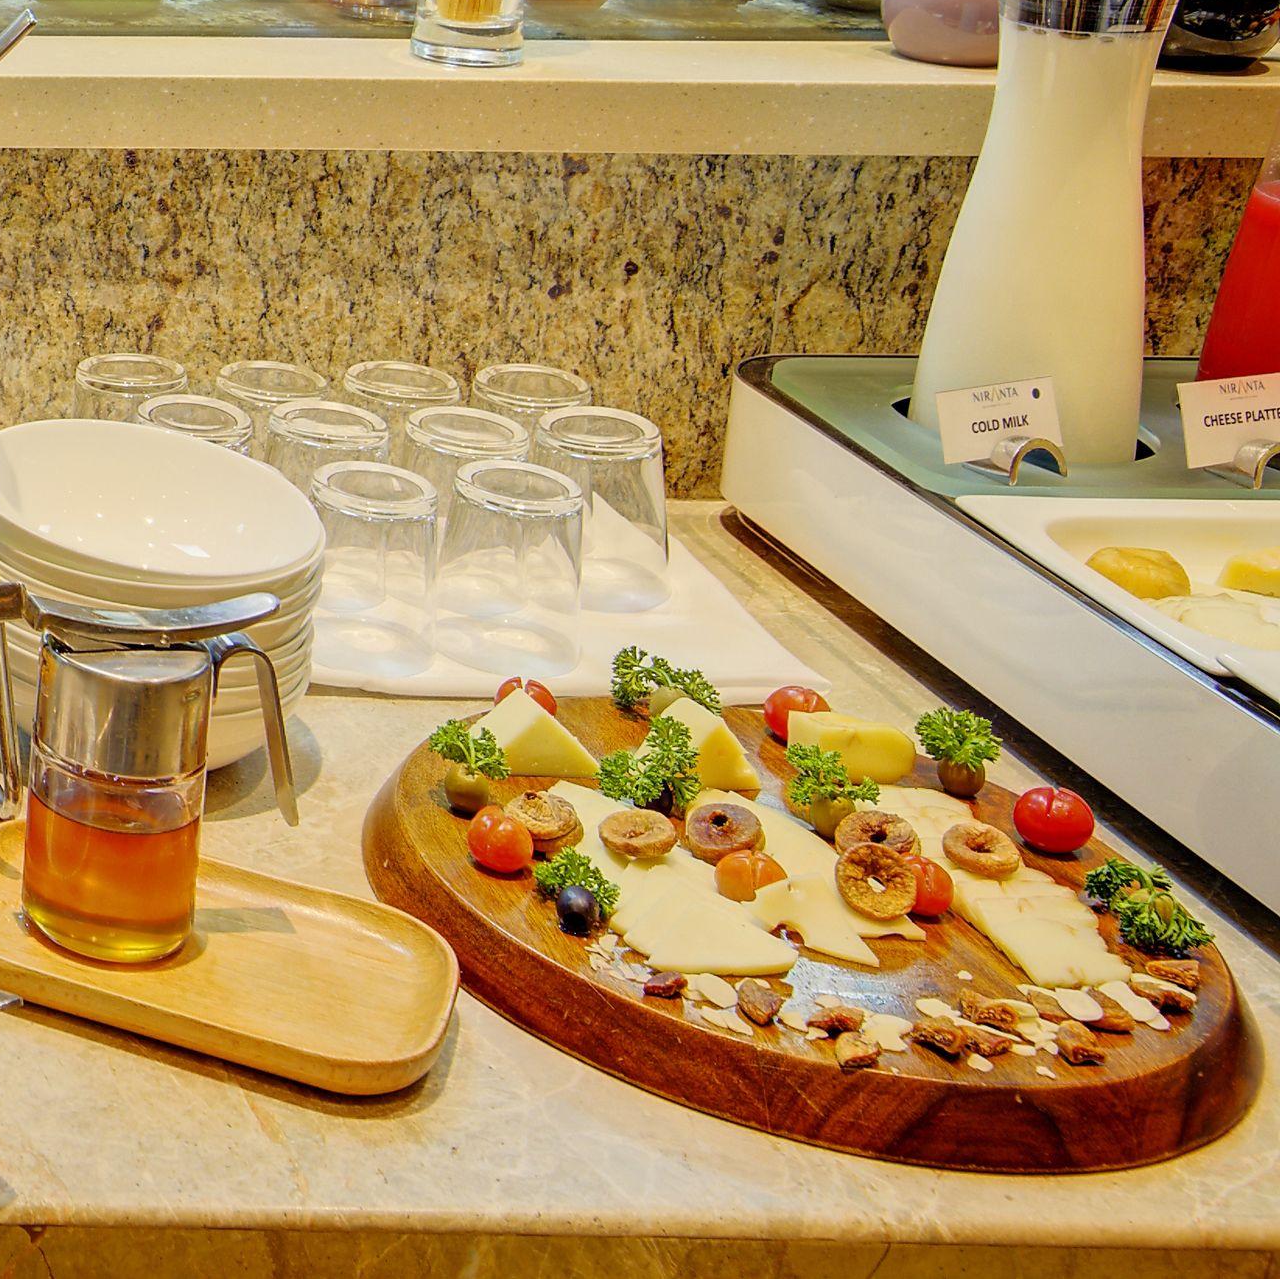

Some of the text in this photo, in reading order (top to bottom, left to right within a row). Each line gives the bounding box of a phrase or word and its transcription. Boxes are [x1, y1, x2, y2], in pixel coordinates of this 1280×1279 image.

[1219, 379, 1266, 394] NIRANTA
[972, 387, 1019, 402] NIRANTA
[971, 414, 1029, 434] COLD MILK
[1203, 412, 1243, 428] CHEESE
